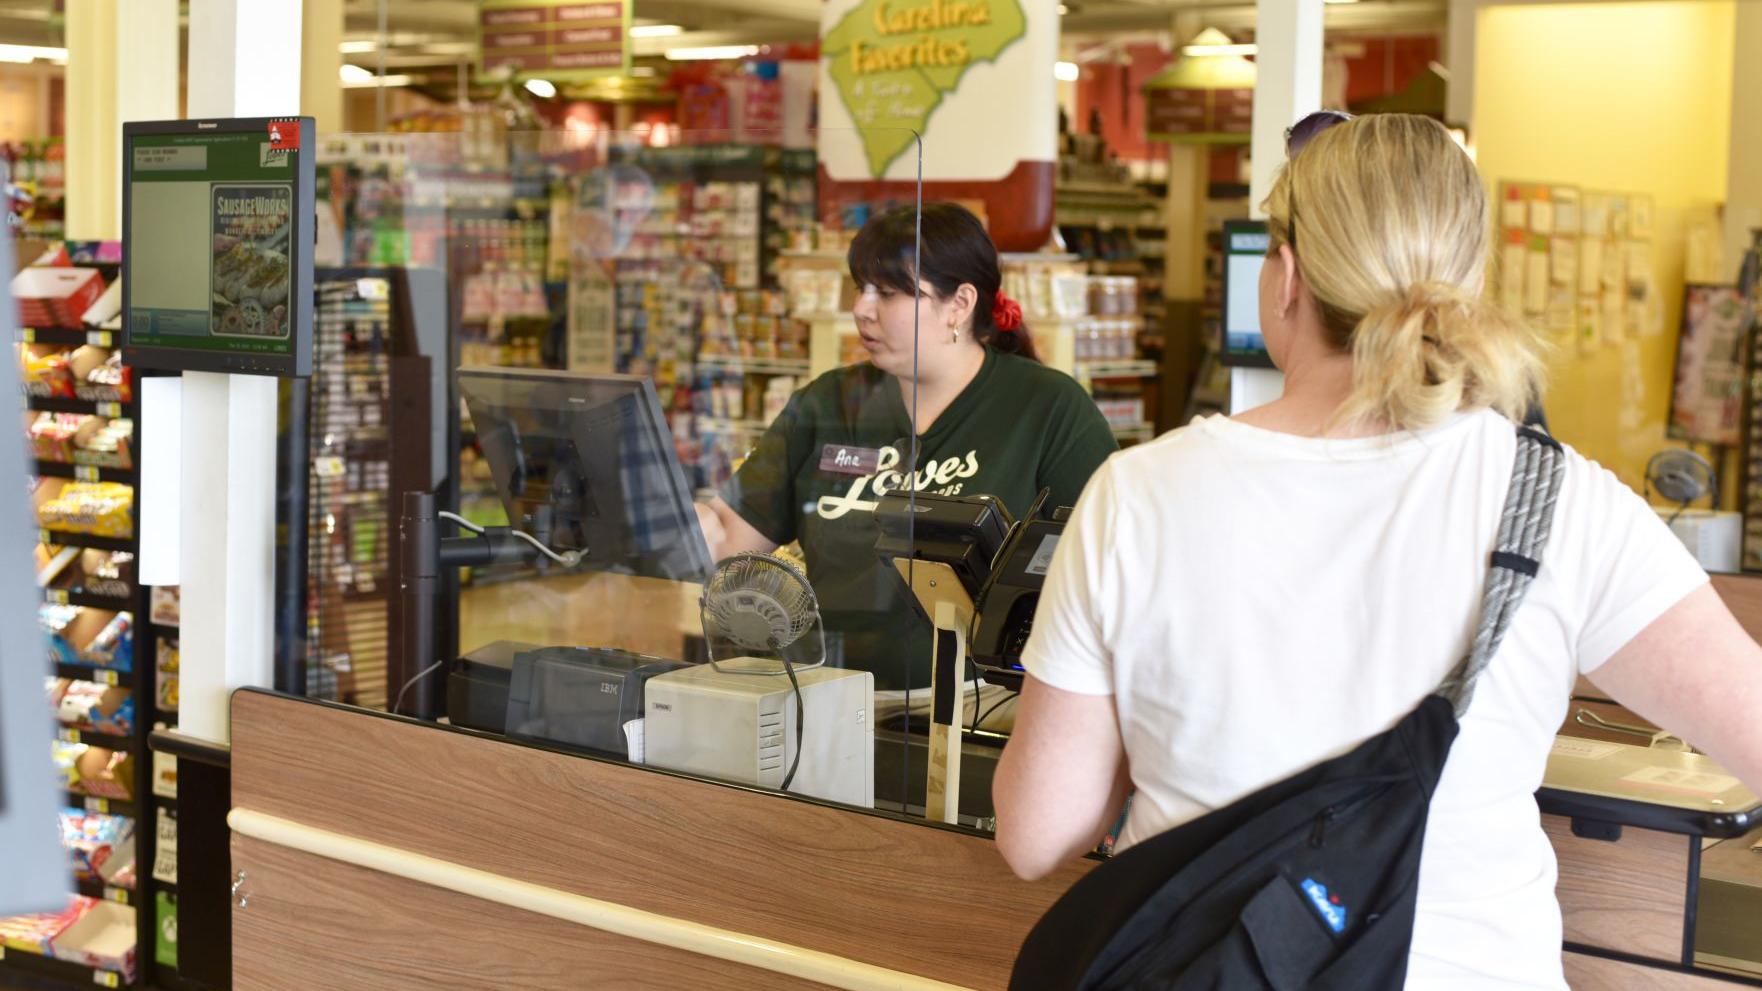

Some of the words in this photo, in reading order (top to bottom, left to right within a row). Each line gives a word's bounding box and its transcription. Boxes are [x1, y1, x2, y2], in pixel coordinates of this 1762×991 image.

[874, 0, 991, 35] Carolina
[852, 36, 970, 74] Favorites
[834, 448, 862, 467] Ana
[600, 682, 618, 695] IBM
